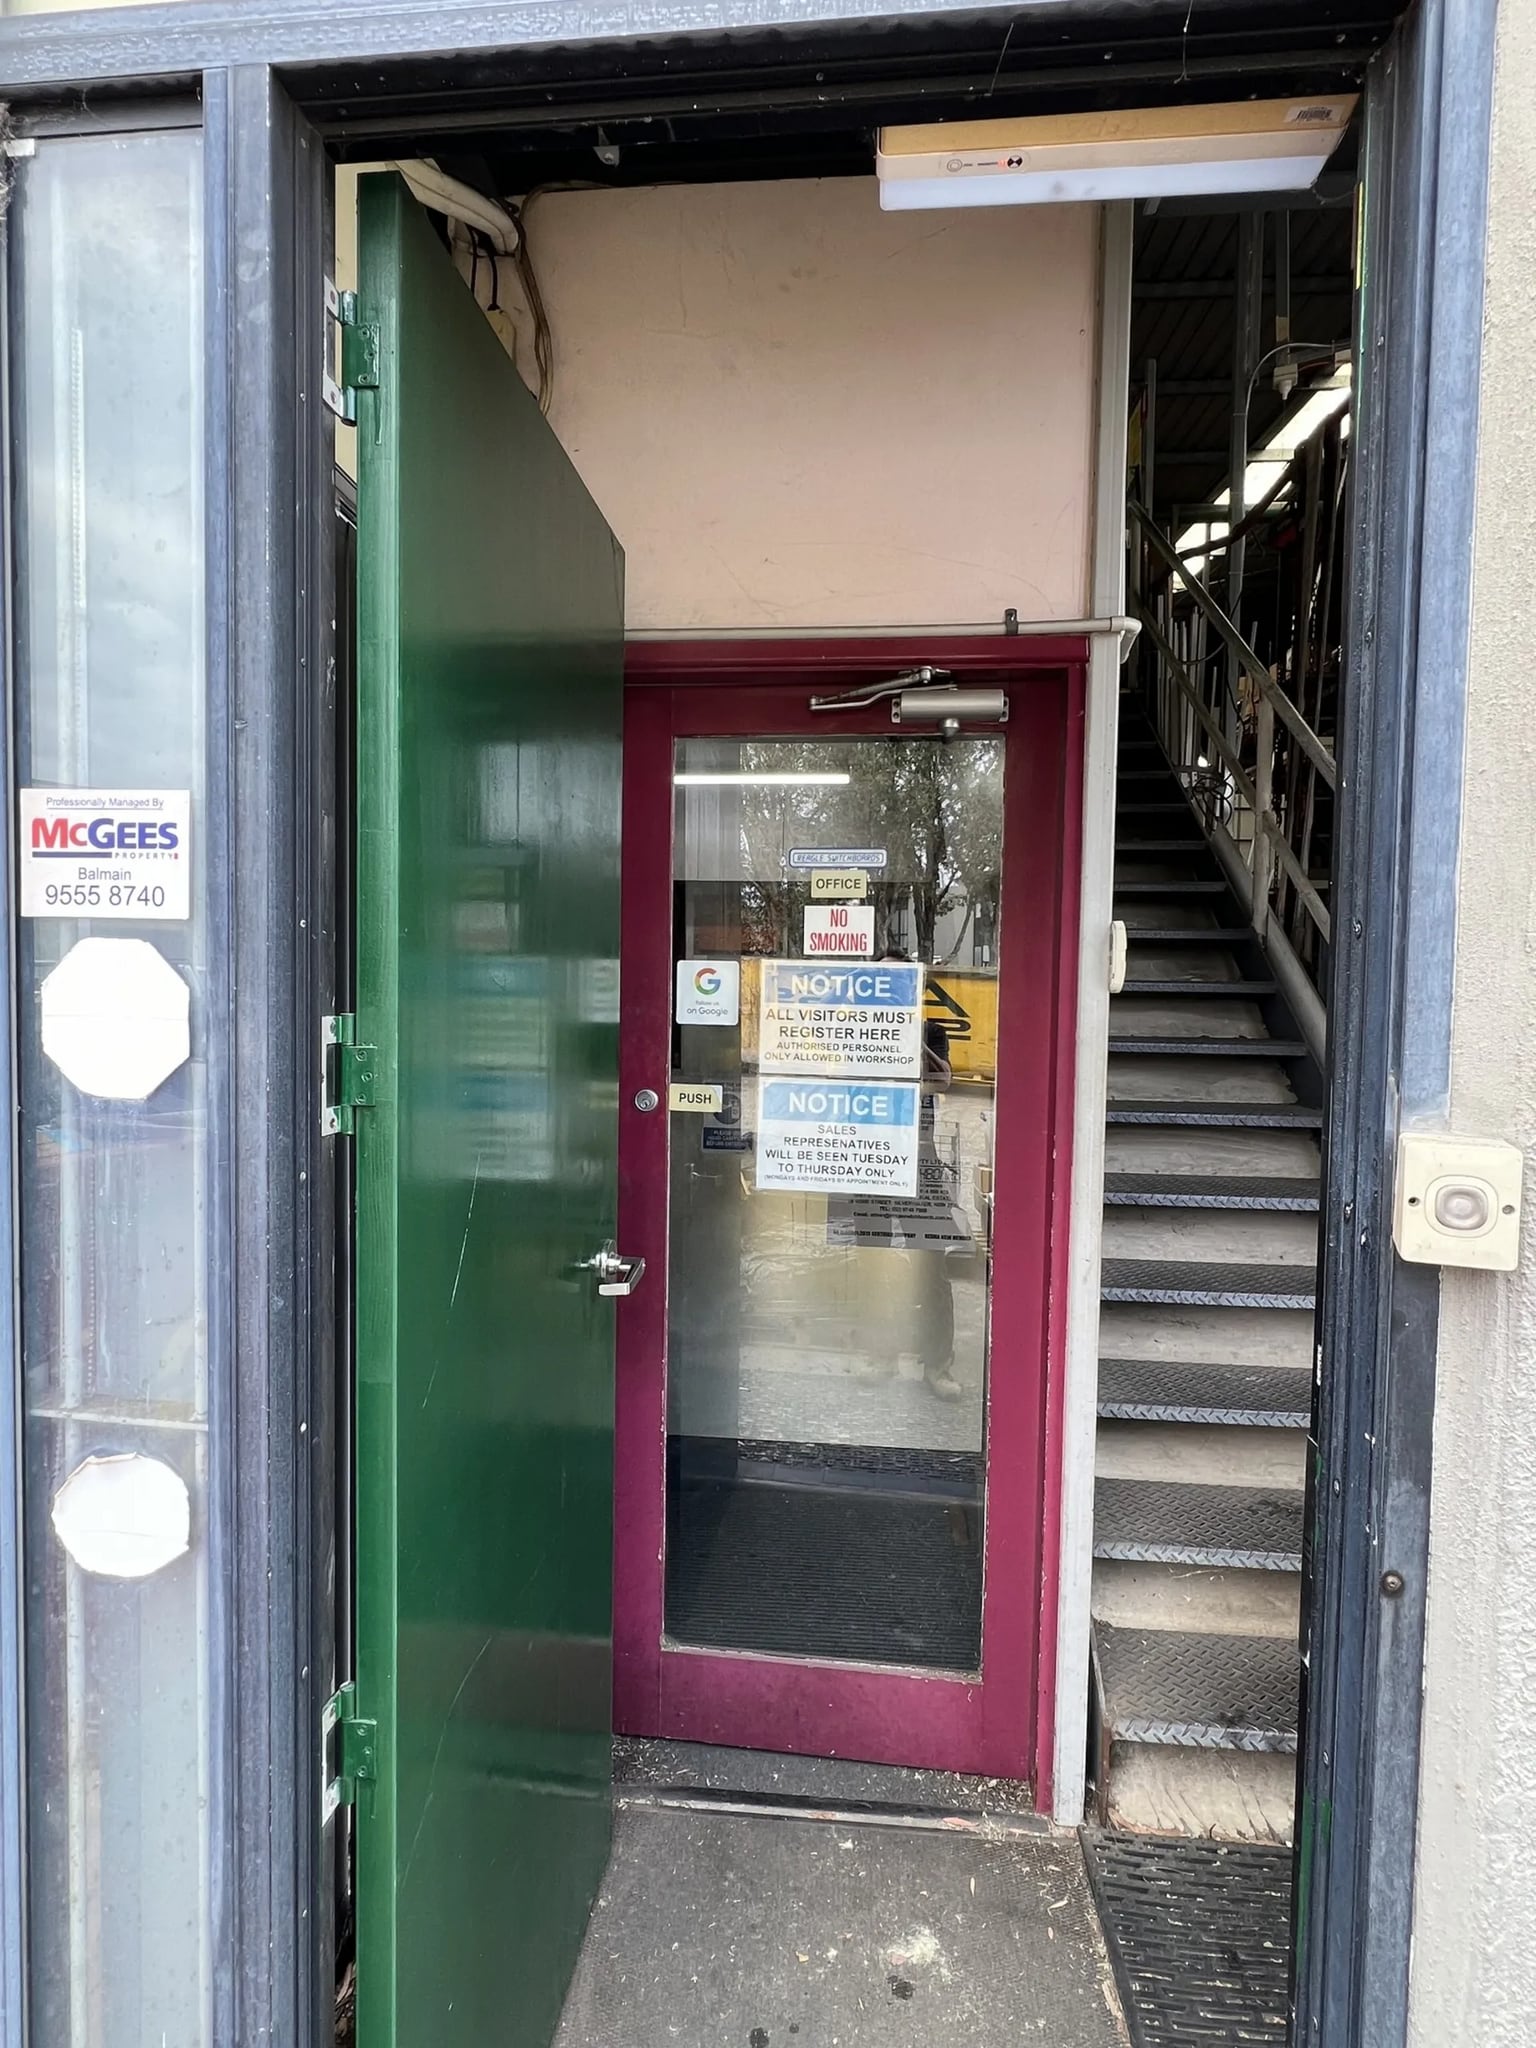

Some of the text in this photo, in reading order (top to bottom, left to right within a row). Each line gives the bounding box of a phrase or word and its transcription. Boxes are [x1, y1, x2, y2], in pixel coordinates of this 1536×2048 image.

[46, 797, 164, 809] Professionally Managed By
[114, 852, 173, 860] PROPERTY
[78, 867, 132, 880] Balmain
[816, 879, 861, 889] OFFICE
[45, 884, 165, 907] 9555 8740
[830, 909, 847, 927] NO
[810, 933, 867, 951] SMOKING
[791, 975, 891, 998] NOTICE
[698, 1007, 728, 1016] Google
[766, 1009, 915, 1024] ALL VISITORS MUST
[779, 1026, 900, 1041] REGISTER HERE
[777, 1042, 902, 1053] AUTHORISED PERSONNEL
[764, 1052, 914, 1065] ONLY ALLOWED IN WORKSHOP
[679, 1093, 712, 1104] PUSH
[789, 1092, 888, 1116] NOTICE
[818, 1124, 857, 1135] SALES
[784, 1137, 890, 1150] REPRESENATIVES
[765, 1150, 909, 1165] WILL BE SEEN TUESDAY
[778, 1163, 895, 1178] TO THURSDAY ONLY
[810, 1175, 835, 1183] FRIDAYS
